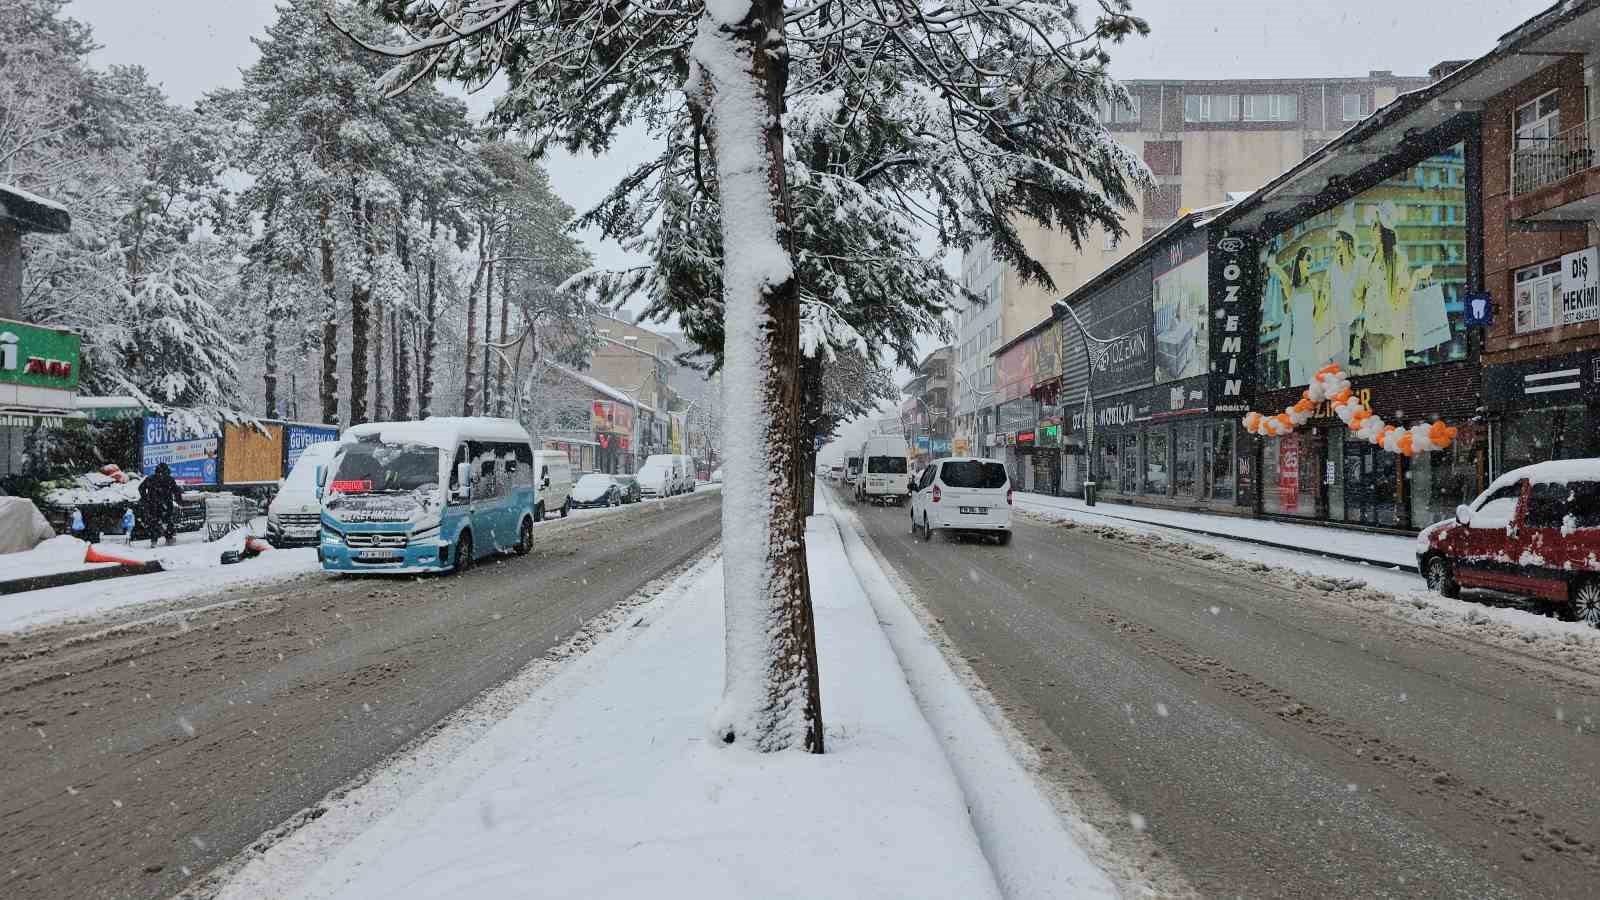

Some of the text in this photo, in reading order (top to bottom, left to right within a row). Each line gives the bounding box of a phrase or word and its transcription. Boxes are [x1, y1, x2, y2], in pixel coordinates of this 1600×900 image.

[1572, 253, 1588, 281] DİŞ
[1563, 281, 1598, 312] HEKİMİ
[1221, 259, 1242, 396] ÖZEMİN
[24, 356, 71, 379] AVM
[41, 415, 63, 432] AVM
